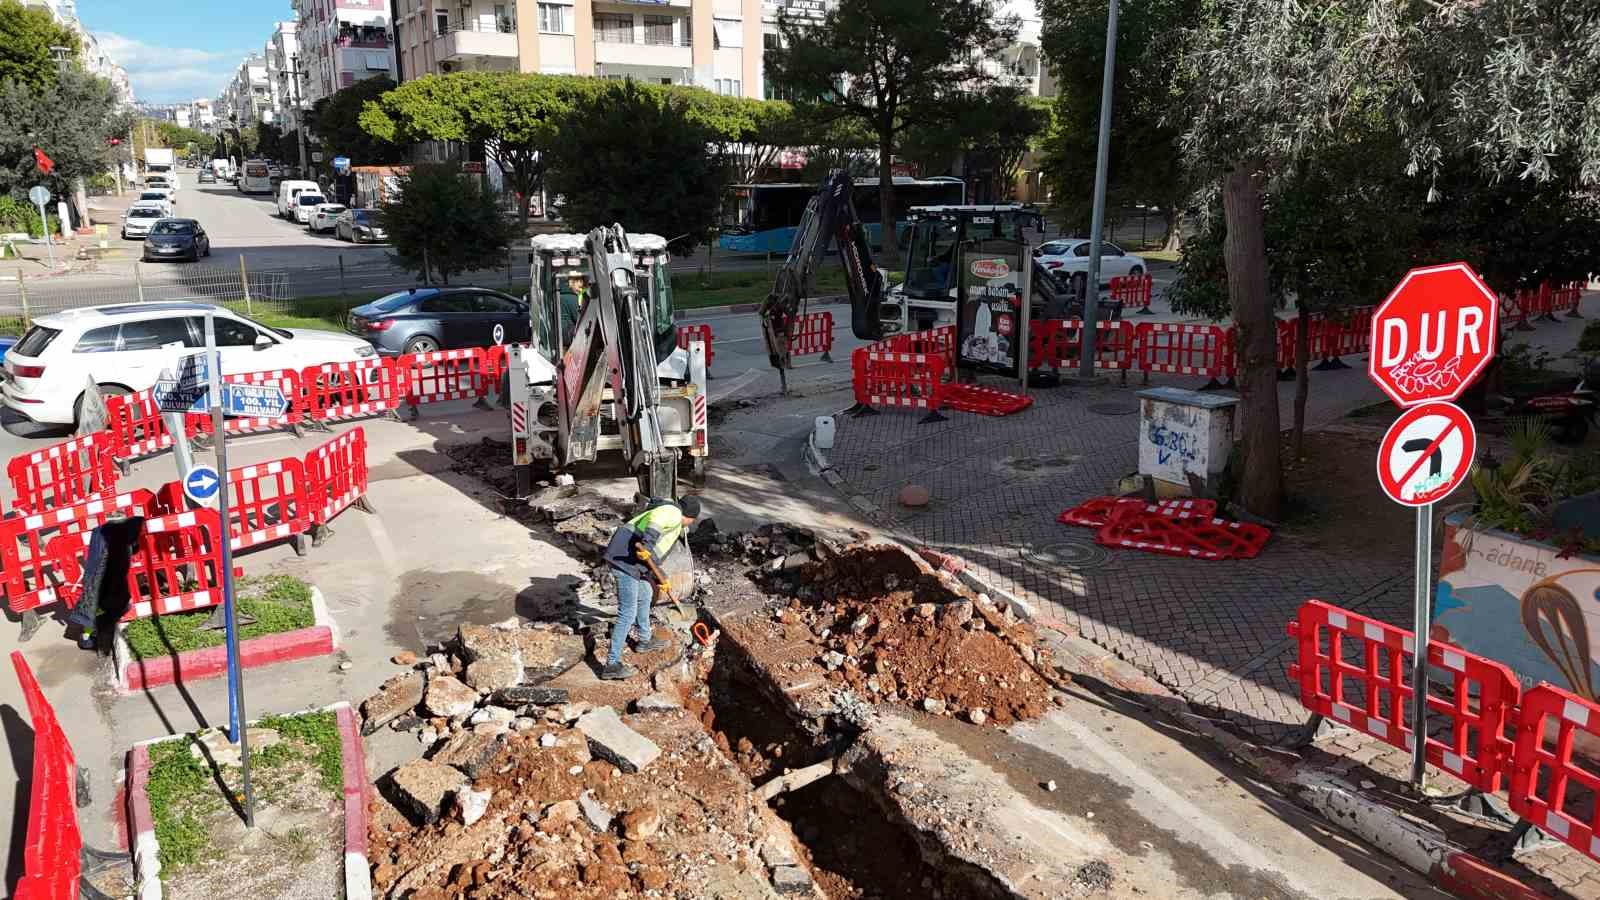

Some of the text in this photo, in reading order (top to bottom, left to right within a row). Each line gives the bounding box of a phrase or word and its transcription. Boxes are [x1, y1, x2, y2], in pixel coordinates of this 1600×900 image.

[1382, 306, 1484, 367] DUR
[264, 398, 281, 407] YIL
[1485, 547, 1548, 577] adana
